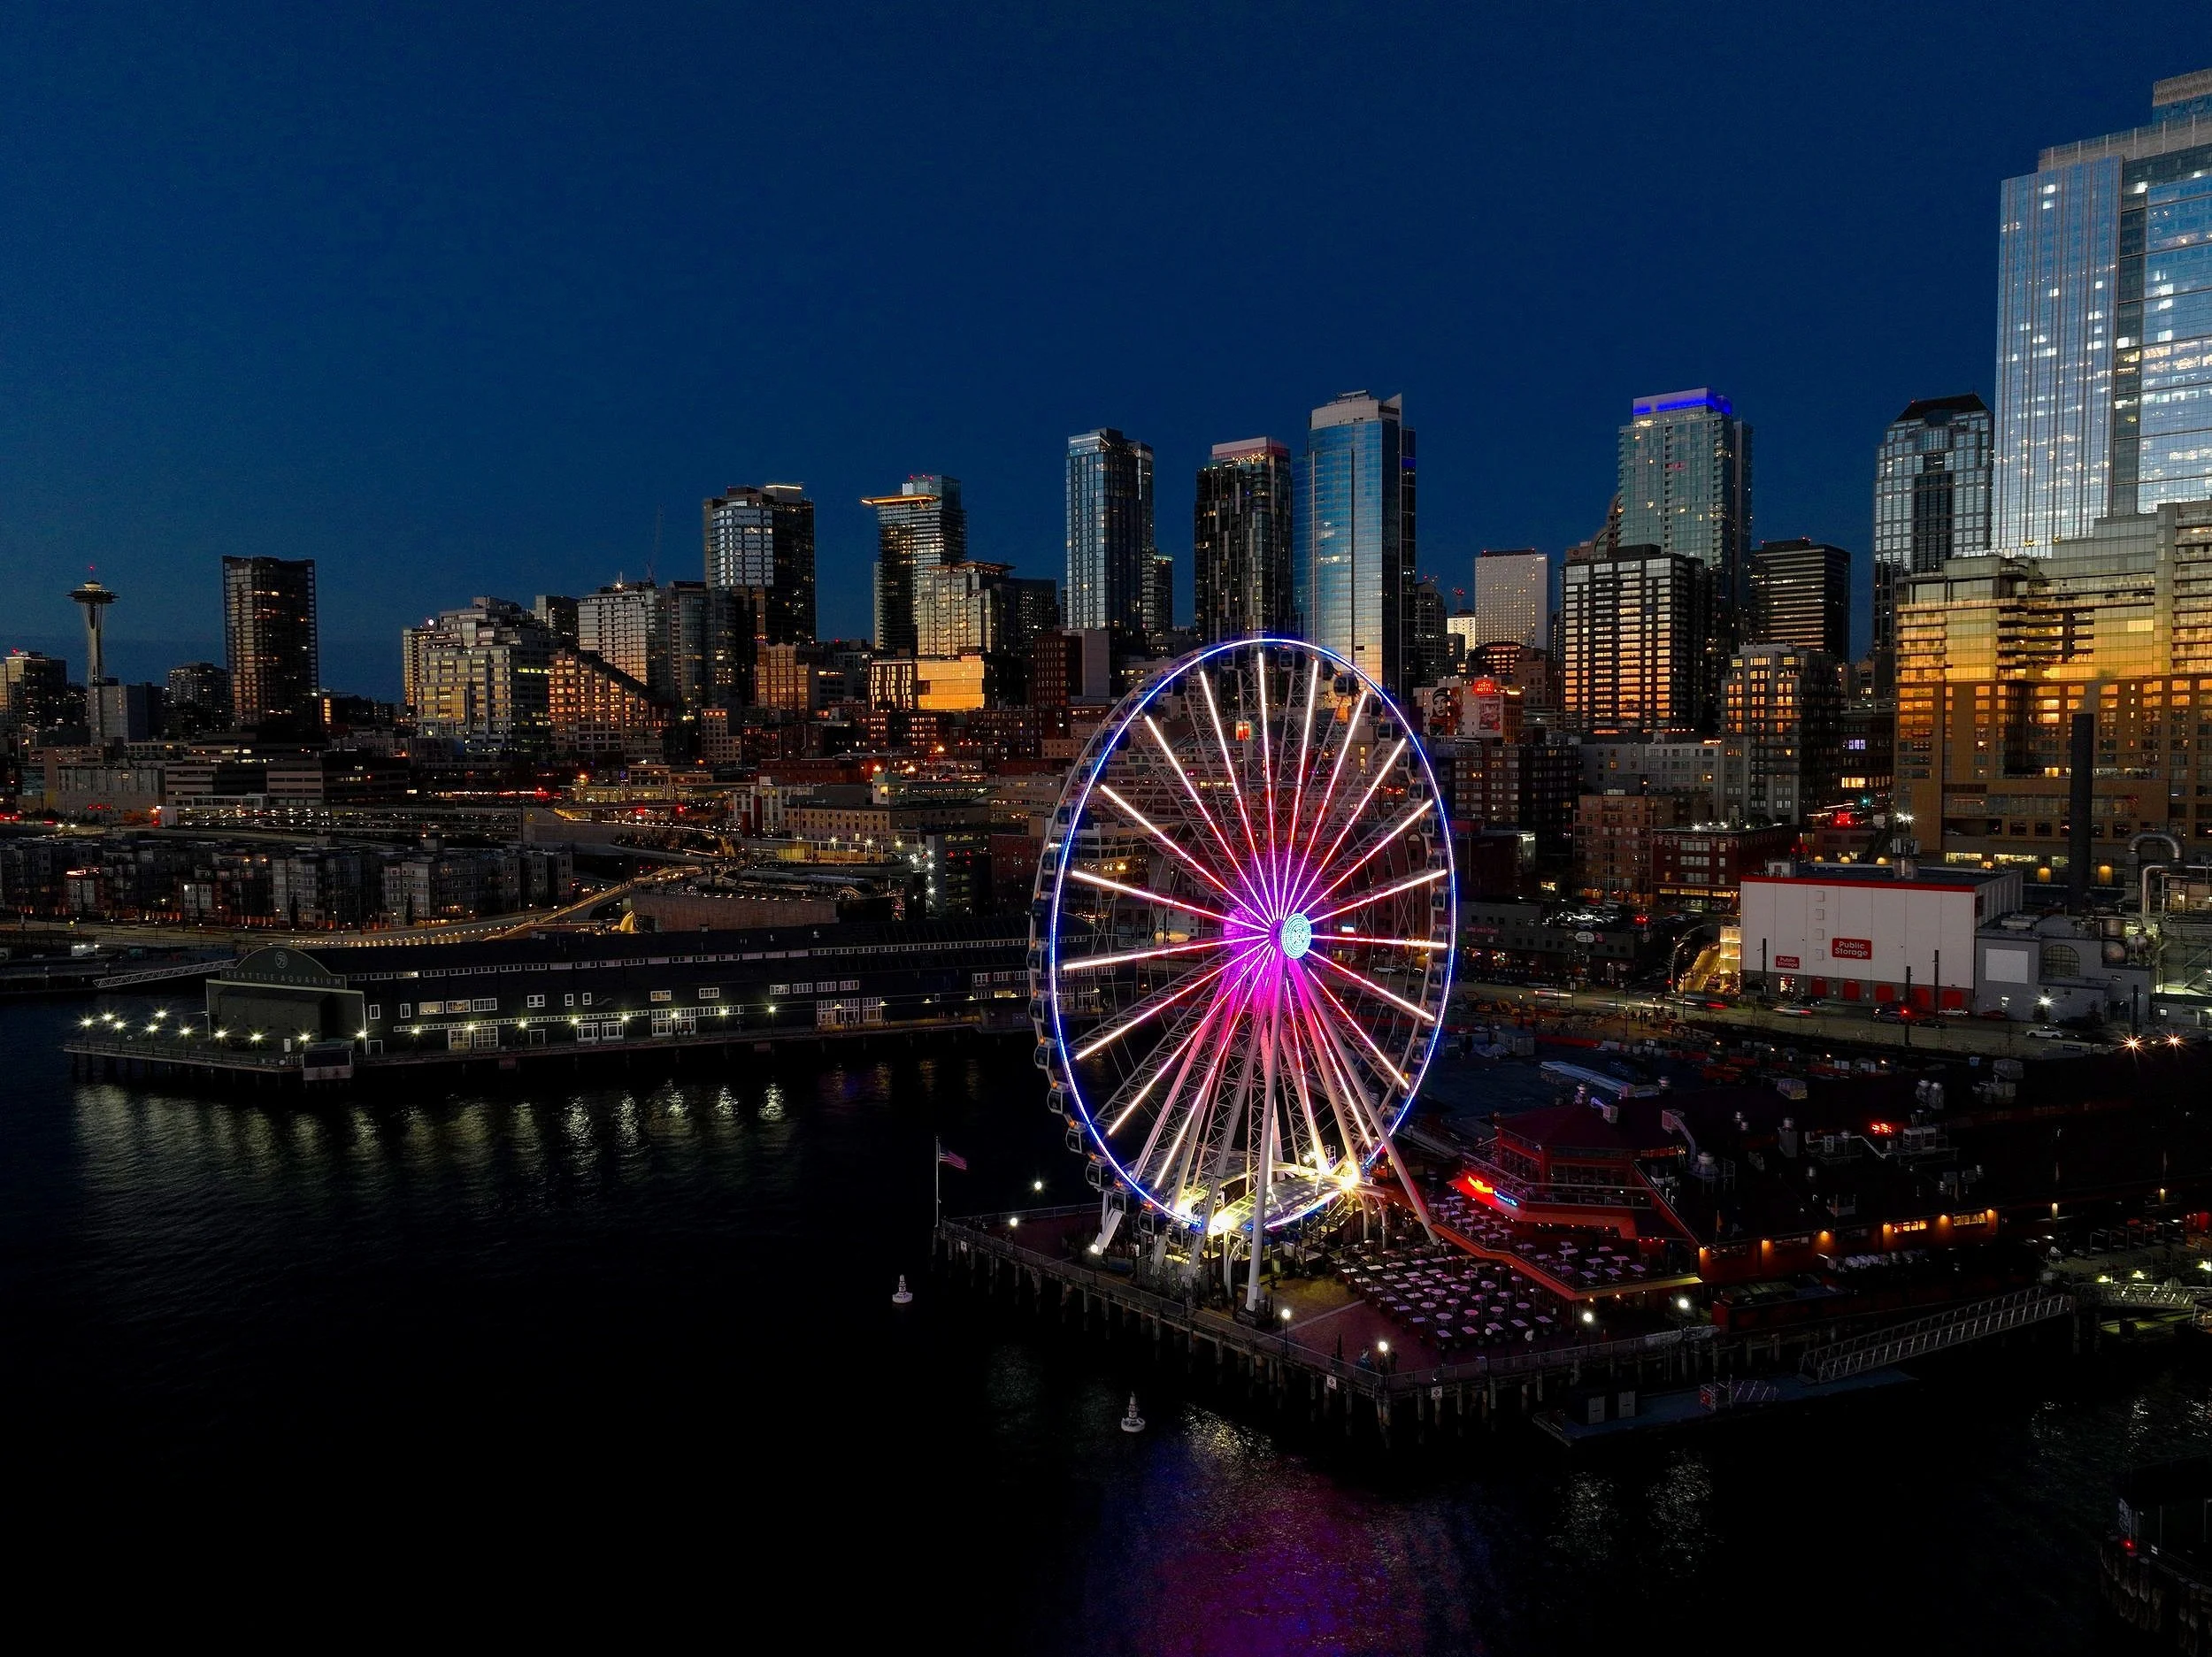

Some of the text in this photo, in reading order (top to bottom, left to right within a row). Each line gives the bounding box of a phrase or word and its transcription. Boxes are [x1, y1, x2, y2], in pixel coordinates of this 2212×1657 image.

[1839, 940, 1865, 949] Public
[1834, 947, 1869, 957] Storage
[226, 970, 342, 986] SEATTLE AQUARIUM
